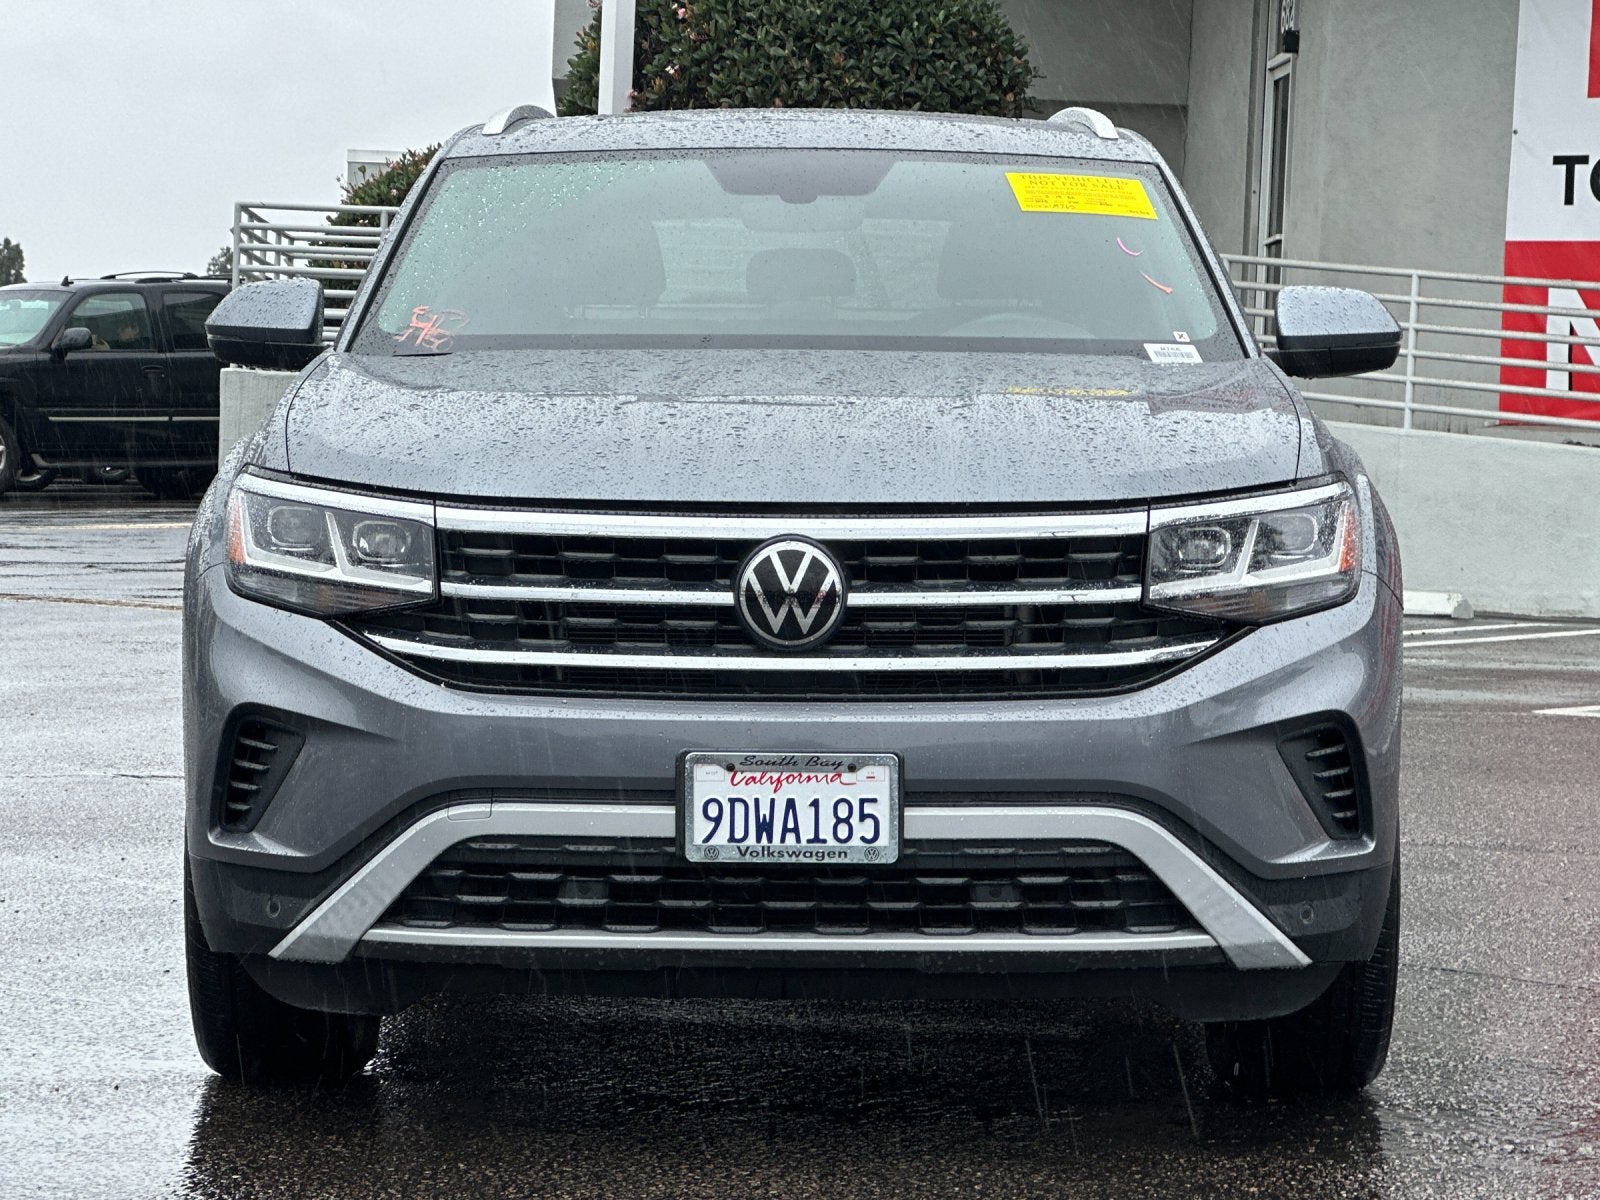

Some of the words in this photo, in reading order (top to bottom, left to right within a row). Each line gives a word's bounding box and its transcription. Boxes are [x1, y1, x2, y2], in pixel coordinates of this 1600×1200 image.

[1054, 175, 1111, 183] VEHICLE
[739, 755, 799, 767] South
[805, 756, 845, 770] Bay
[730, 771, 857, 794] California
[702, 797, 880, 844] 9DWA185
[736, 846, 848, 860] Volkswagen
